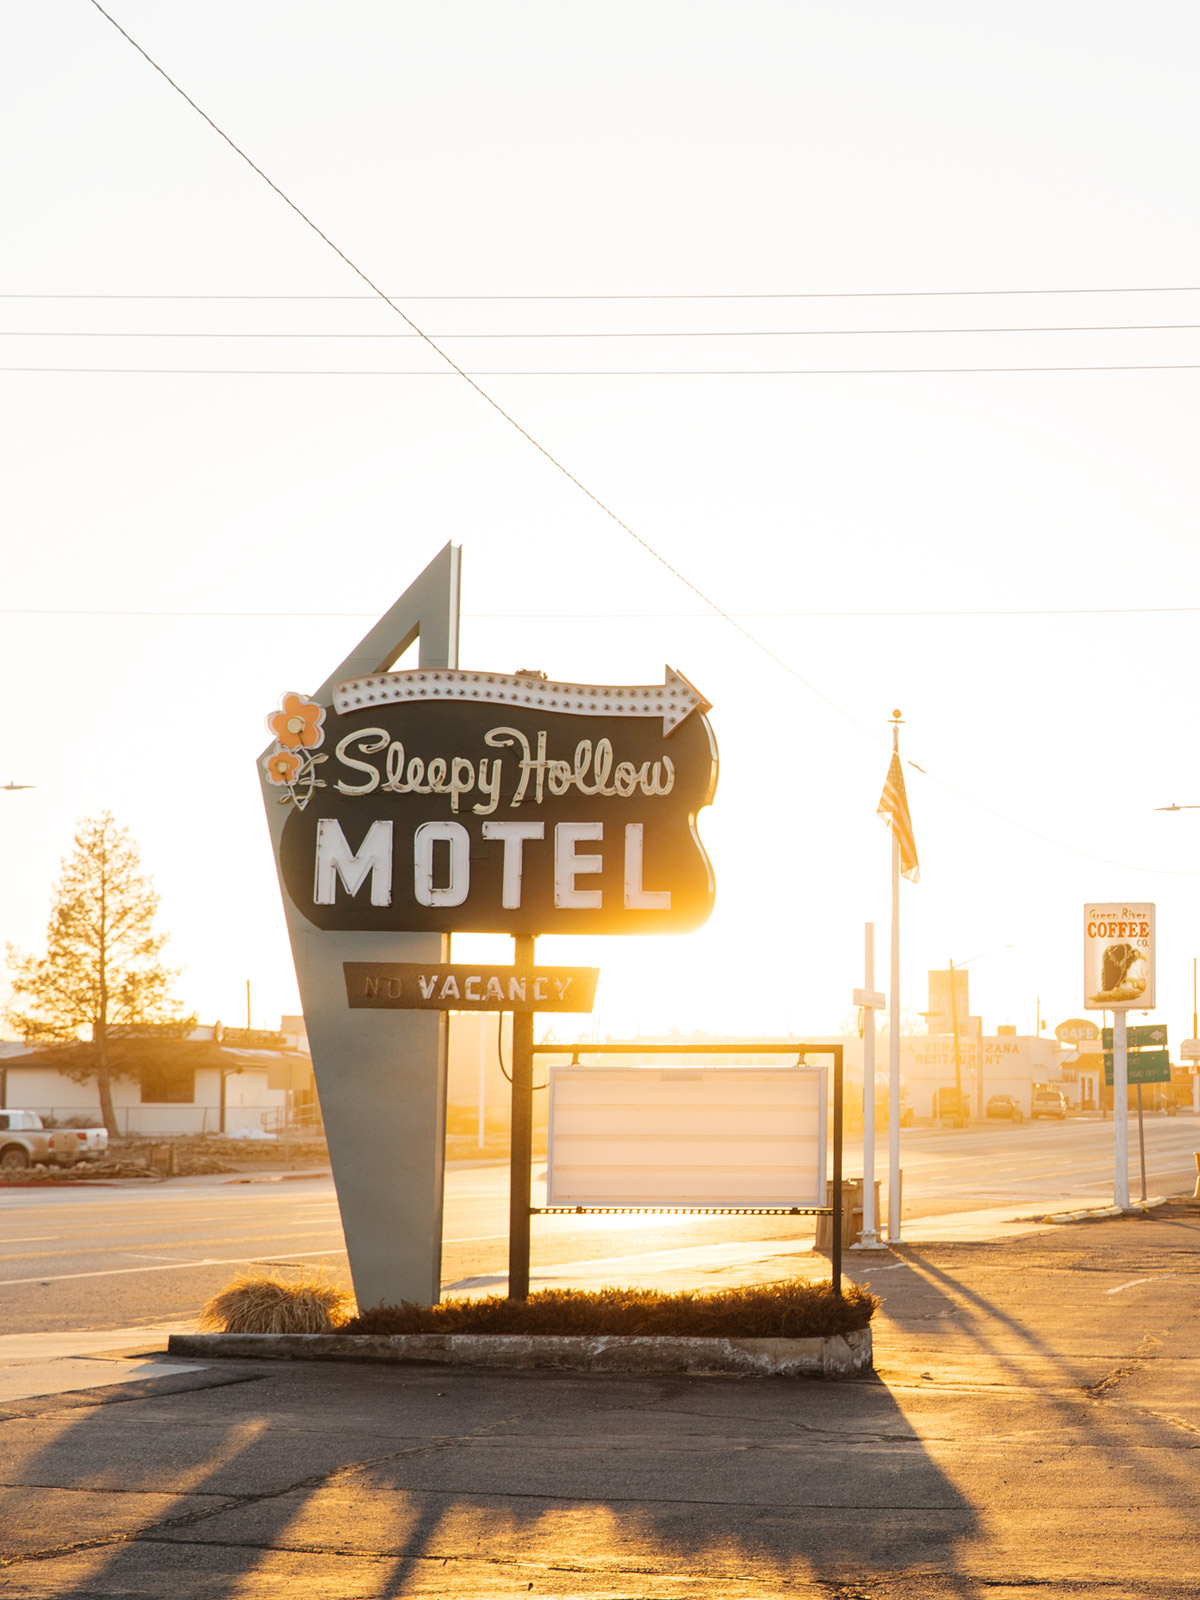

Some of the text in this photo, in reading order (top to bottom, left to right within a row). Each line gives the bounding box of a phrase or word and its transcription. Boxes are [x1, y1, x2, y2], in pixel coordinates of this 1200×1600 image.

[333, 726, 676, 814] Sleepy Hollow
[313, 819, 672, 910] MOTEL
[1089, 907, 1147, 920] Green River
[1087, 921, 1150, 938] COFFEE
[363, 974, 573, 1001] NO VACANCY
[1060, 1027, 1094, 1040] CAFE
